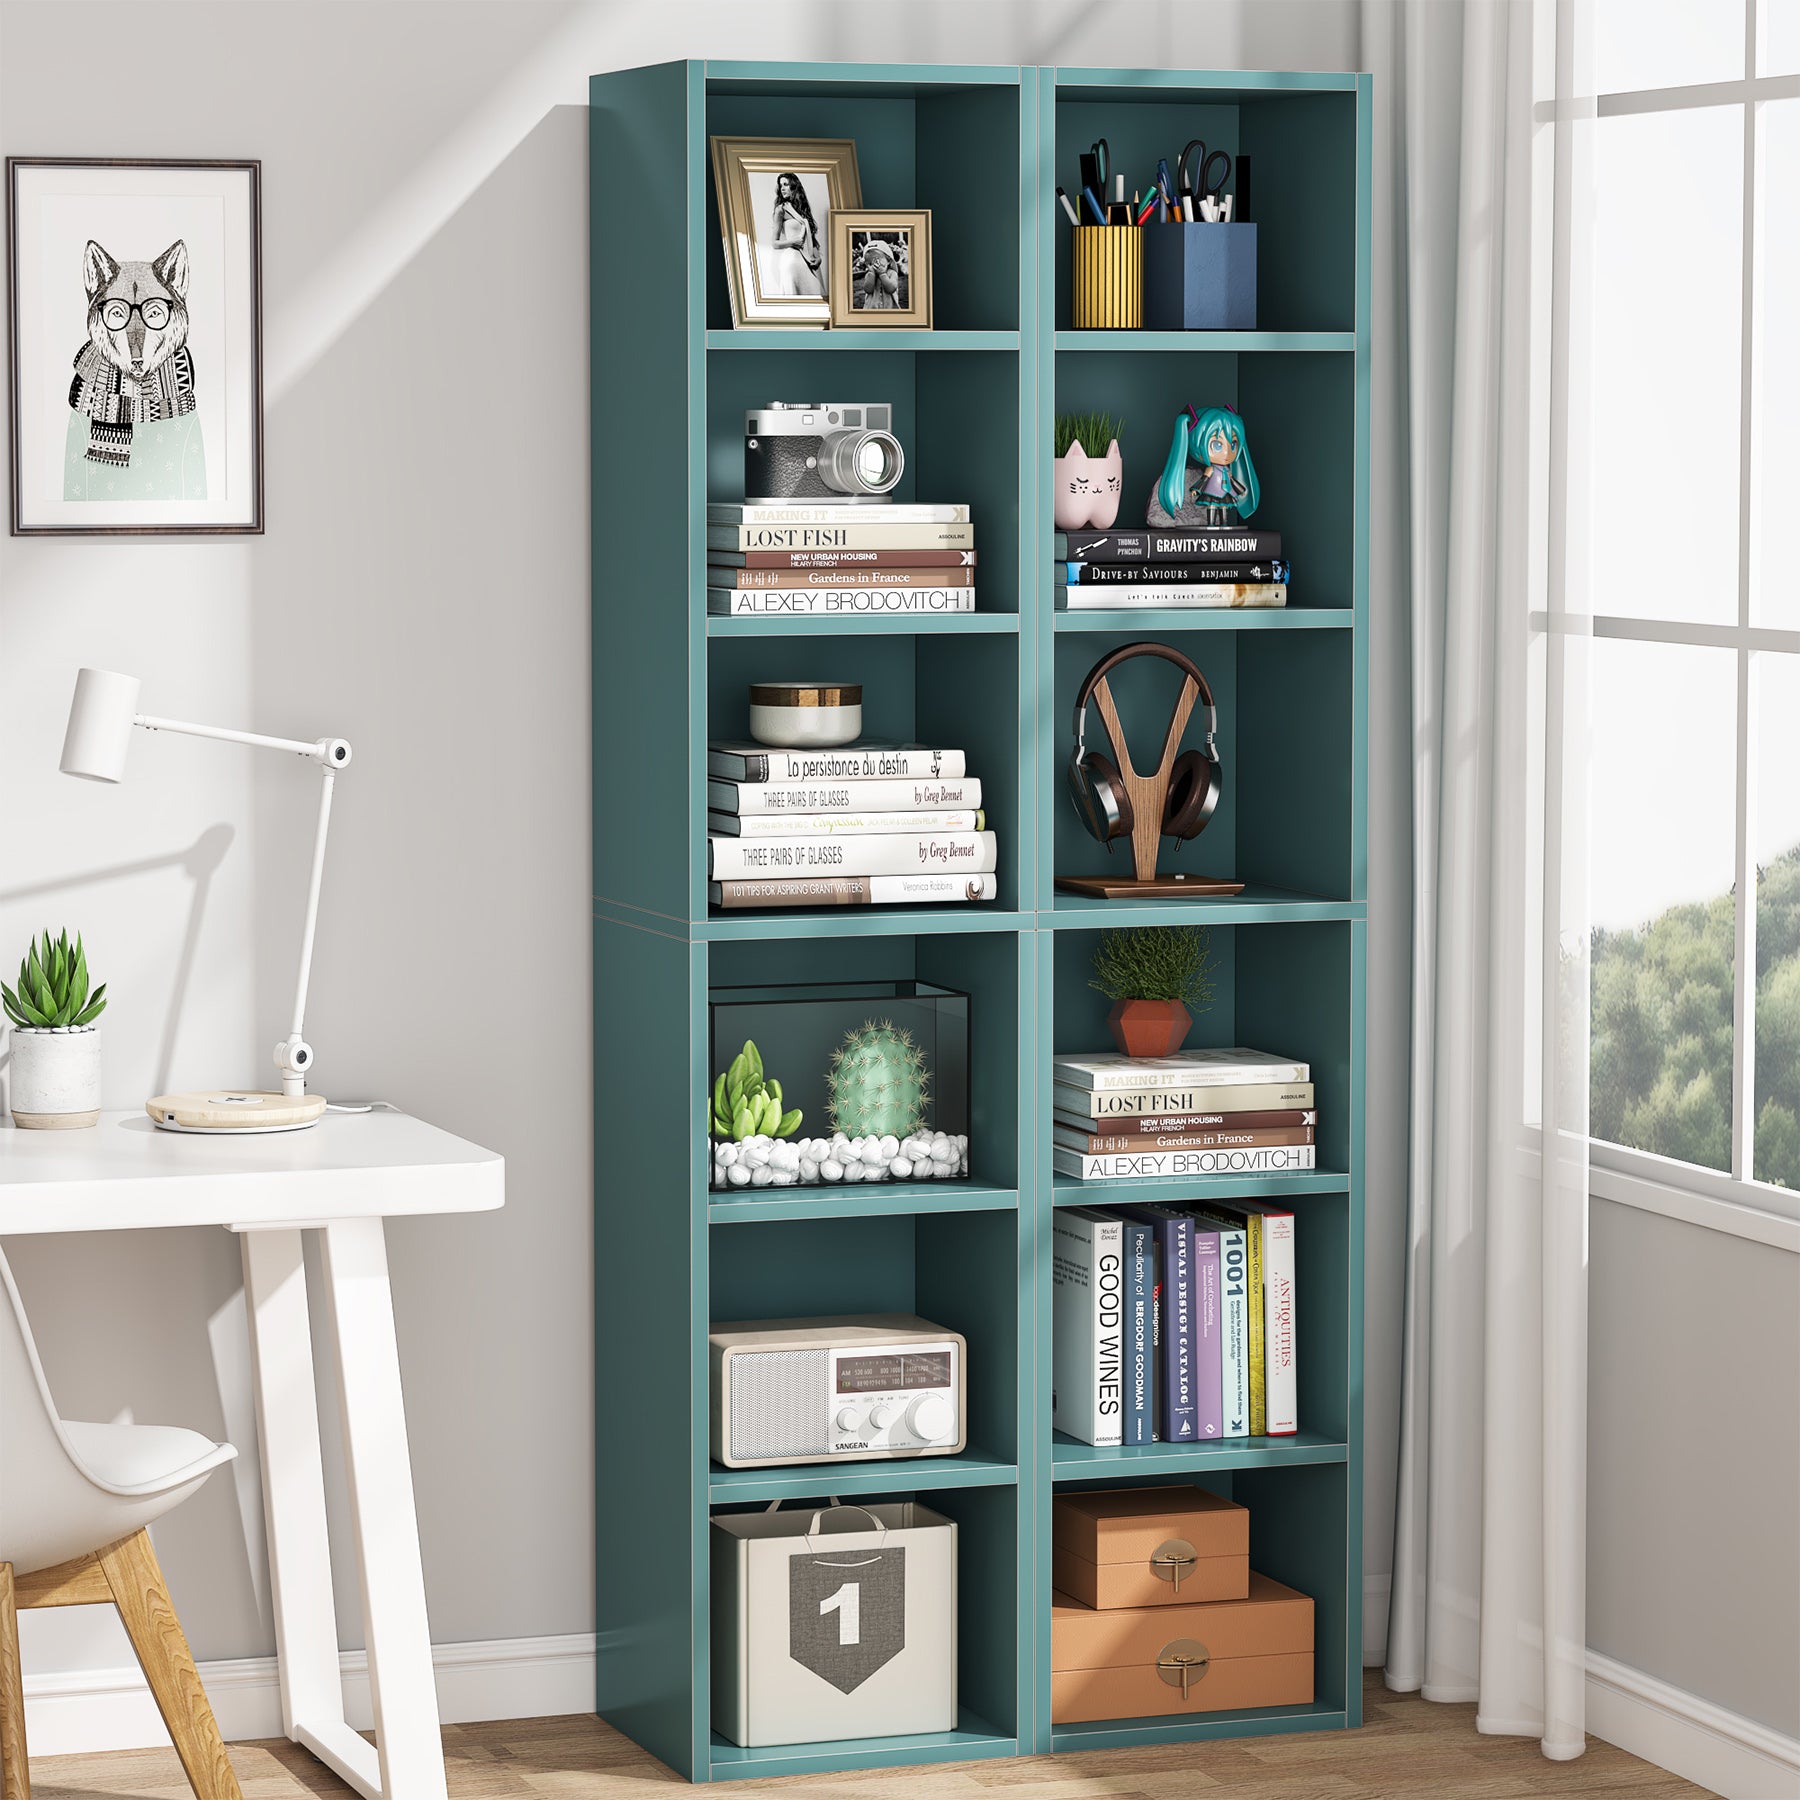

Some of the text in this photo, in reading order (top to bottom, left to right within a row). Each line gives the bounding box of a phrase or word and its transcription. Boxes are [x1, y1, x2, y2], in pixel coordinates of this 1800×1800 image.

[753, 510, 812, 522] MAKING
[813, 510, 828, 521] IT
[746, 529, 847, 547] LOST FISH
[1117, 538, 1139, 546] THOMAS
[1156, 538, 1257, 553] GRAVITY'S RAINBOW
[790, 552, 877, 561] NEW URBAN HOUSING
[808, 572, 910, 585] Gardens in France
[1092, 567, 1188, 580] DRIVE-BY SAVIOURS
[1201, 570, 1239, 579] BENJAMIN
[737, 590, 960, 612] ALEXEY BRODOVITCH
[786, 754, 800, 778] La
[801, 752, 860, 783] persistance
[862, 752, 877, 776] du
[879, 752, 909, 776] destin
[764, 790, 850, 808] THREE PAIRS OF GLASSES
[914, 786, 963, 805] by Greg Bennet
[743, 846, 843, 866] THREE PAIRS OF GLASSES
[919, 843, 975, 862] by Greg Bennet
[732, 882, 864, 897] 101 TIPS FOR ASPIRING GRANT WRITERS
[1104, 1075, 1157, 1087] MAKING
[1160, 1074, 1175, 1085] IT
[1098, 1093, 1194, 1113] LOST FISH
[1188, 1116, 1223, 1124] HOUSING
[1157, 1134, 1253, 1147] Gardens in France
[1089, 1150, 1300, 1177] ALEXEY BRODOVITCH
[1177, 1223, 1187, 1278] VISUAL
[1226, 1233, 1244, 1296] 1001
[1178, 1282, 1188, 1334] DESIGN
[1135, 1233, 1145, 1410] Peculiarity of BERGDORF GOODMAN
[1278, 1278, 1291, 1368] ANTIQUITIES
[1099, 1254, 1120, 1415] GOOD WINES
[841, 1369, 851, 1377] AM
[1179, 1337, 1189, 1404] CATALOG
[835, 1442, 868, 1450] SANGEAN
[820, 1582, 860, 1645] 1
